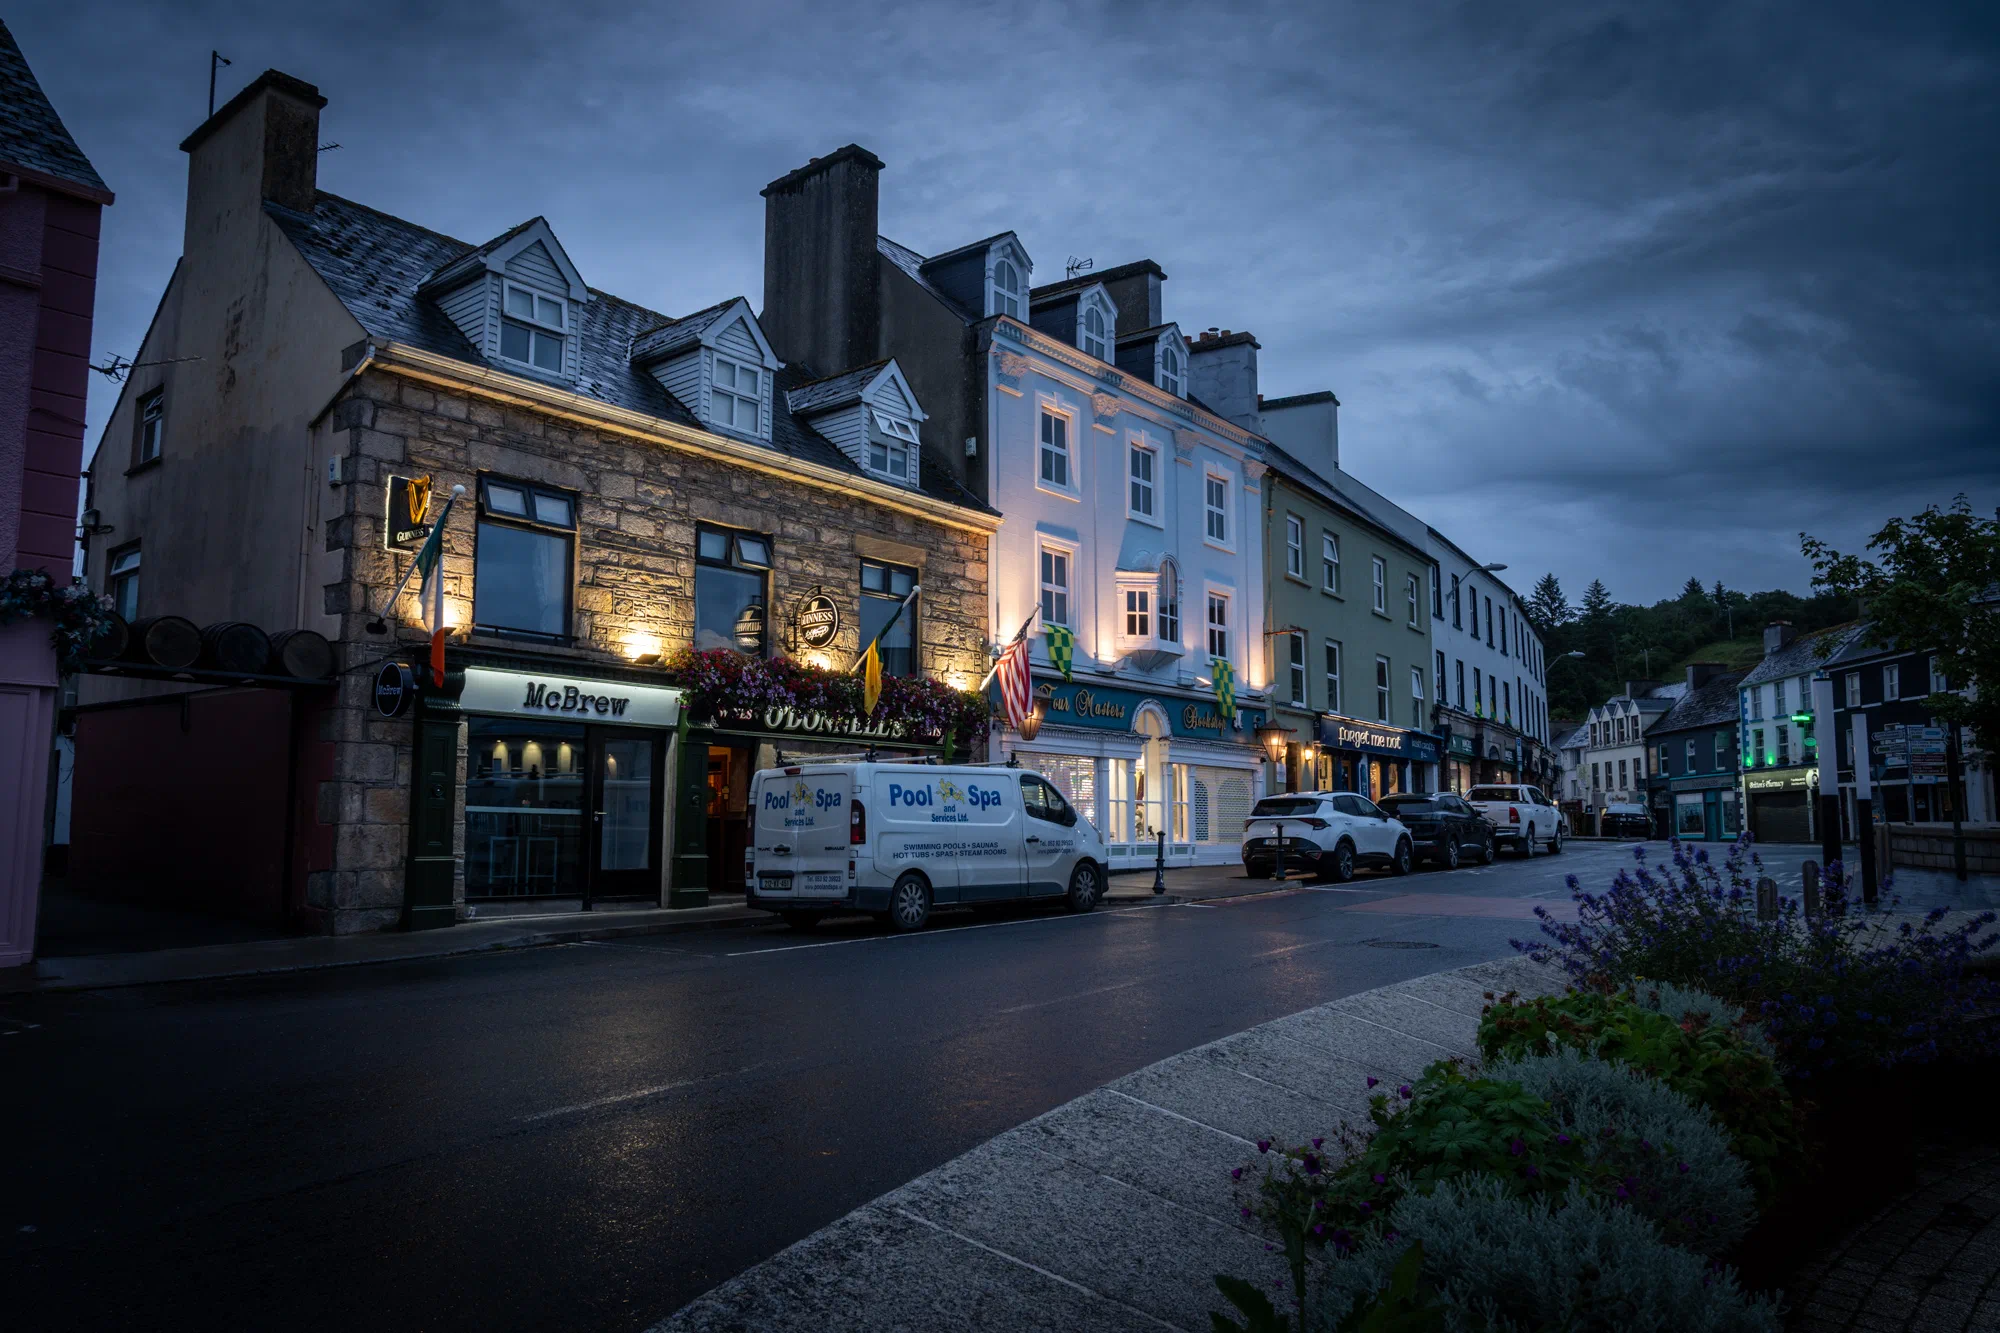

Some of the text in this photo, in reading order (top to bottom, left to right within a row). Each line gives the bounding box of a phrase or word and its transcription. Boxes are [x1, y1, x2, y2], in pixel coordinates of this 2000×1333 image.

[396, 528, 424, 542] GUINNESS
[378, 684, 402, 696] McBrew
[523, 681, 630, 716] McBrew
[1075, 689, 1126, 718] Masters
[1183, 704, 1226, 736] Bookshop
[765, 788, 842, 812] Pool Spa
[889, 784, 1002, 811] Pool Spa
[794, 808, 805, 816] and
[943, 804, 956, 812] and
[784, 817, 815, 827] Services Ltd.
[931, 813, 969, 823] Services Ltd.
[903, 843, 941, 851] SWIMMING
[942, 842, 967, 850] POOLS
[935, 850, 954, 858] SPAS
[959, 849, 982, 857] STEAM
[983, 848, 1007, 856] ROOMS
